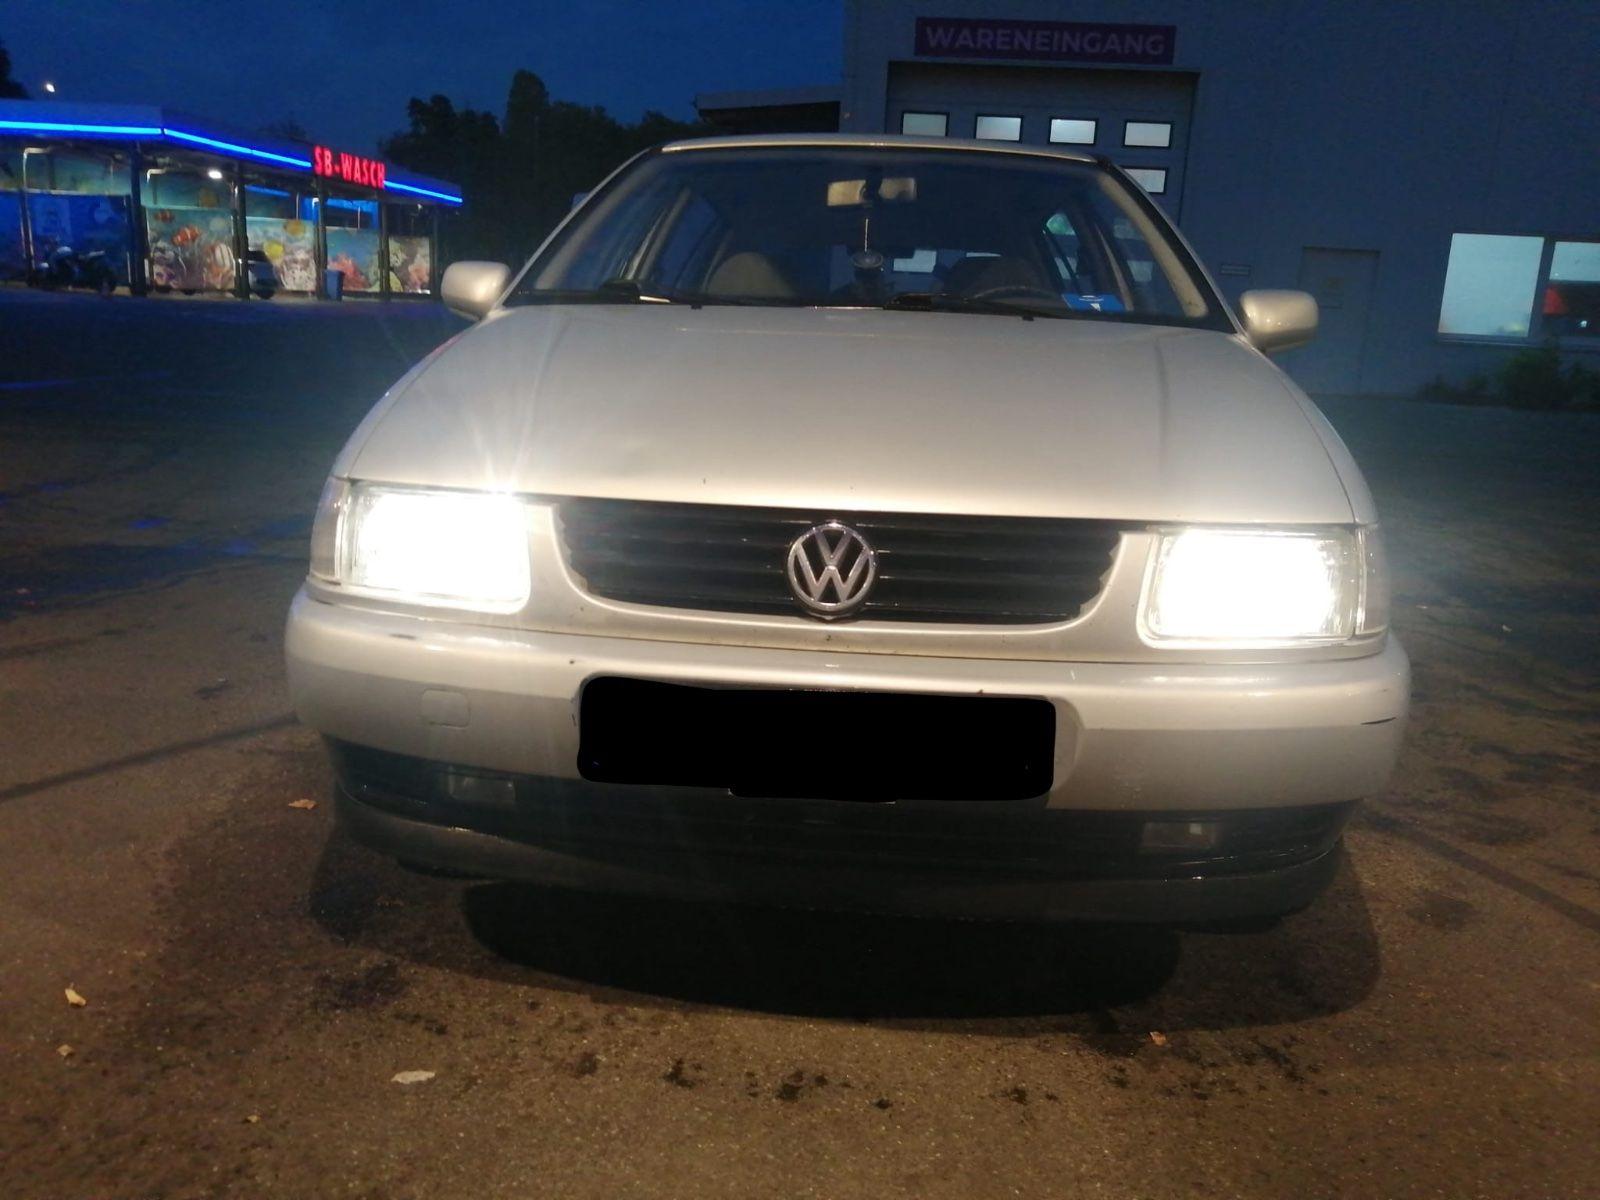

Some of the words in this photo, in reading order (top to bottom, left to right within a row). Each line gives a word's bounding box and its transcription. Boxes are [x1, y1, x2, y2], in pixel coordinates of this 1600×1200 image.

[926, 26, 1165, 56] WARENEINGANG
[314, 144, 385, 190] SB-WASCH
[793, 527, 873, 608] VW
